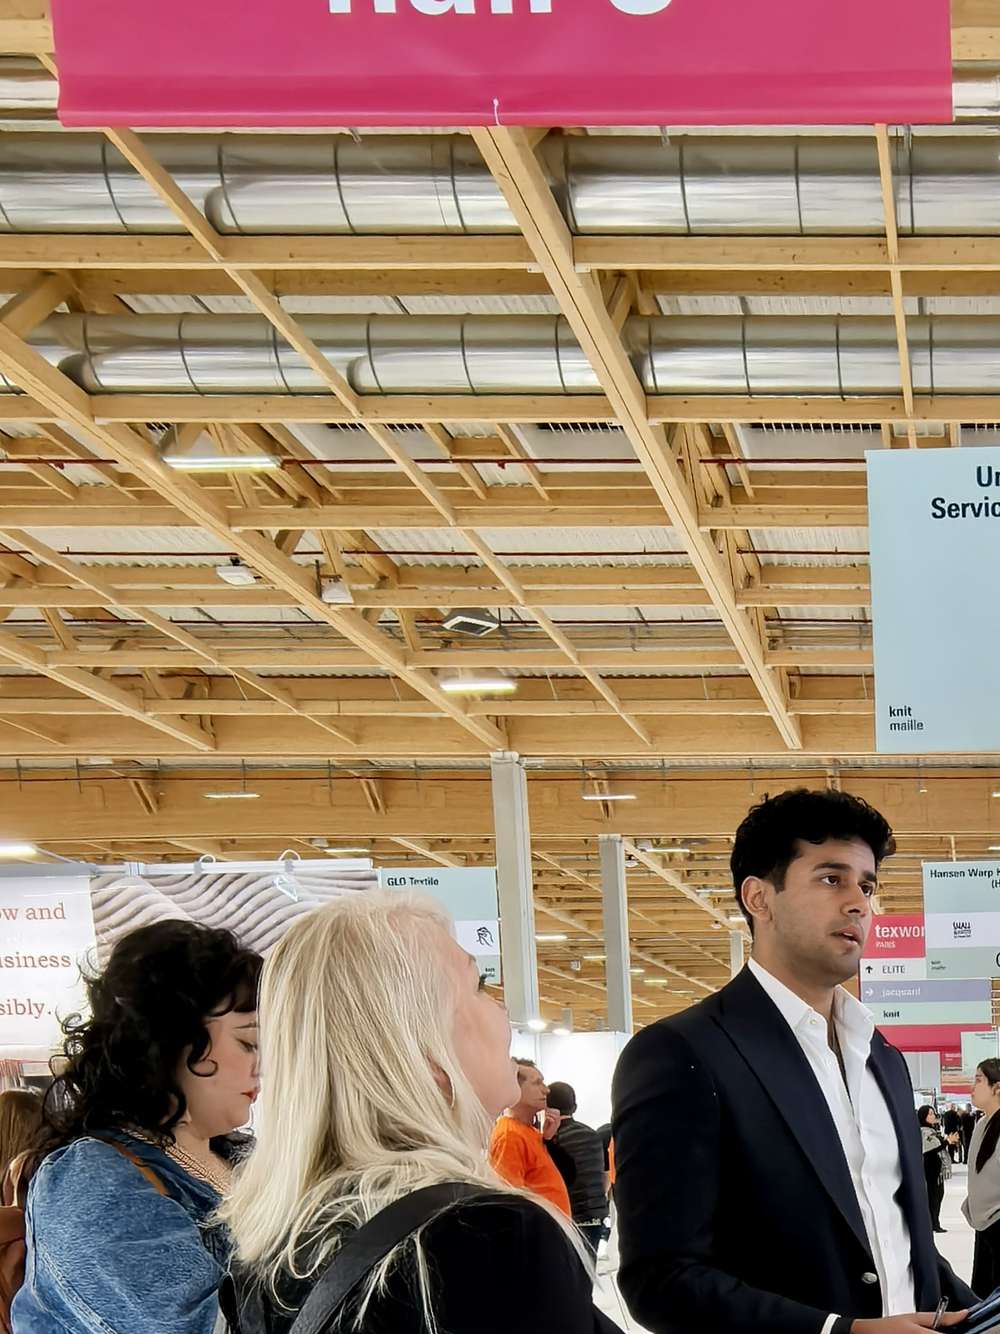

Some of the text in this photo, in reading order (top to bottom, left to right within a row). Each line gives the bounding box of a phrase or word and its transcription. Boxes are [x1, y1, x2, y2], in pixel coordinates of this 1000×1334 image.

[889, 705, 912, 717] knit
[889, 719, 924, 731] maille
[930, 869, 966, 879] Hansen
[968, 868, 993, 880] Warp
[25, 901, 66, 920] and
[883, 1009, 900, 1018] knit
